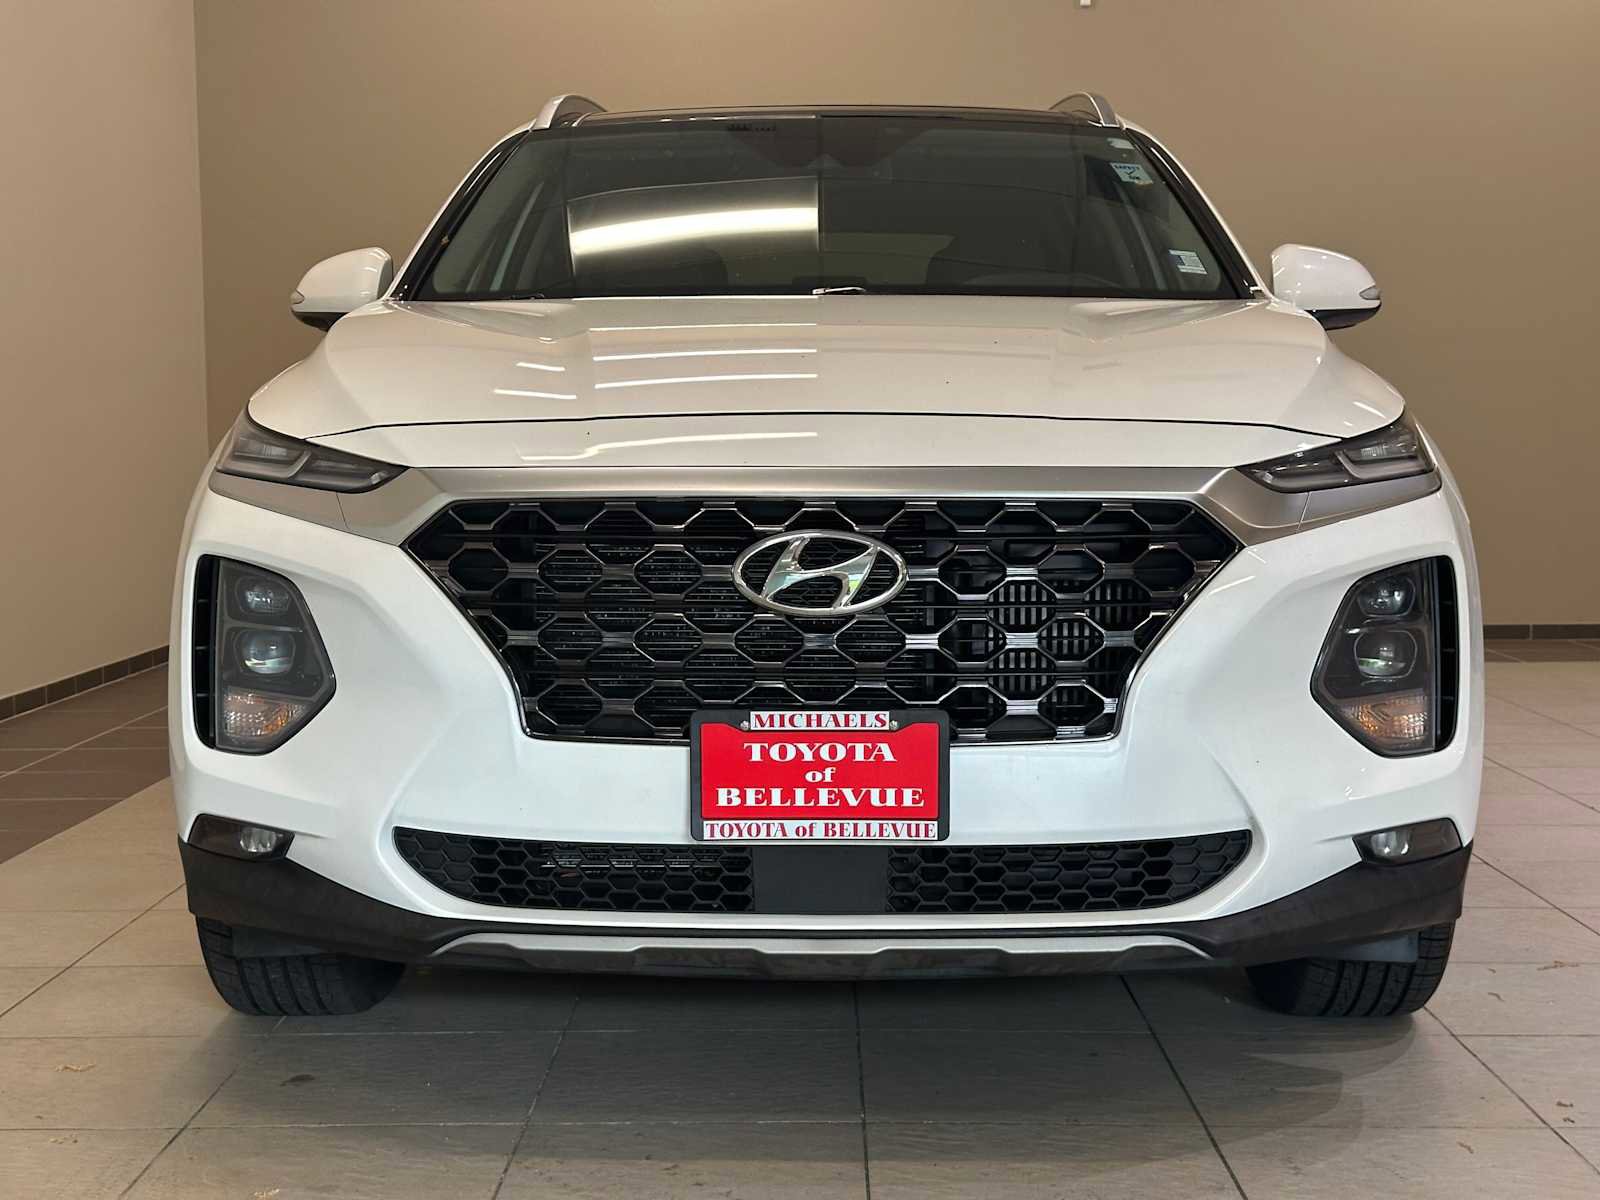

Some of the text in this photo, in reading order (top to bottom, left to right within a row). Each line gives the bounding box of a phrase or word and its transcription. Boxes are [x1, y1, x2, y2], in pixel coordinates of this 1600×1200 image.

[753, 713, 888, 728] MICHAELS
[743, 742, 897, 762] TOYOTA
[805, 767, 836, 783] of
[716, 788, 925, 807] BELLEVUE
[705, 822, 936, 838] TOYOTA of BELLEVUE
